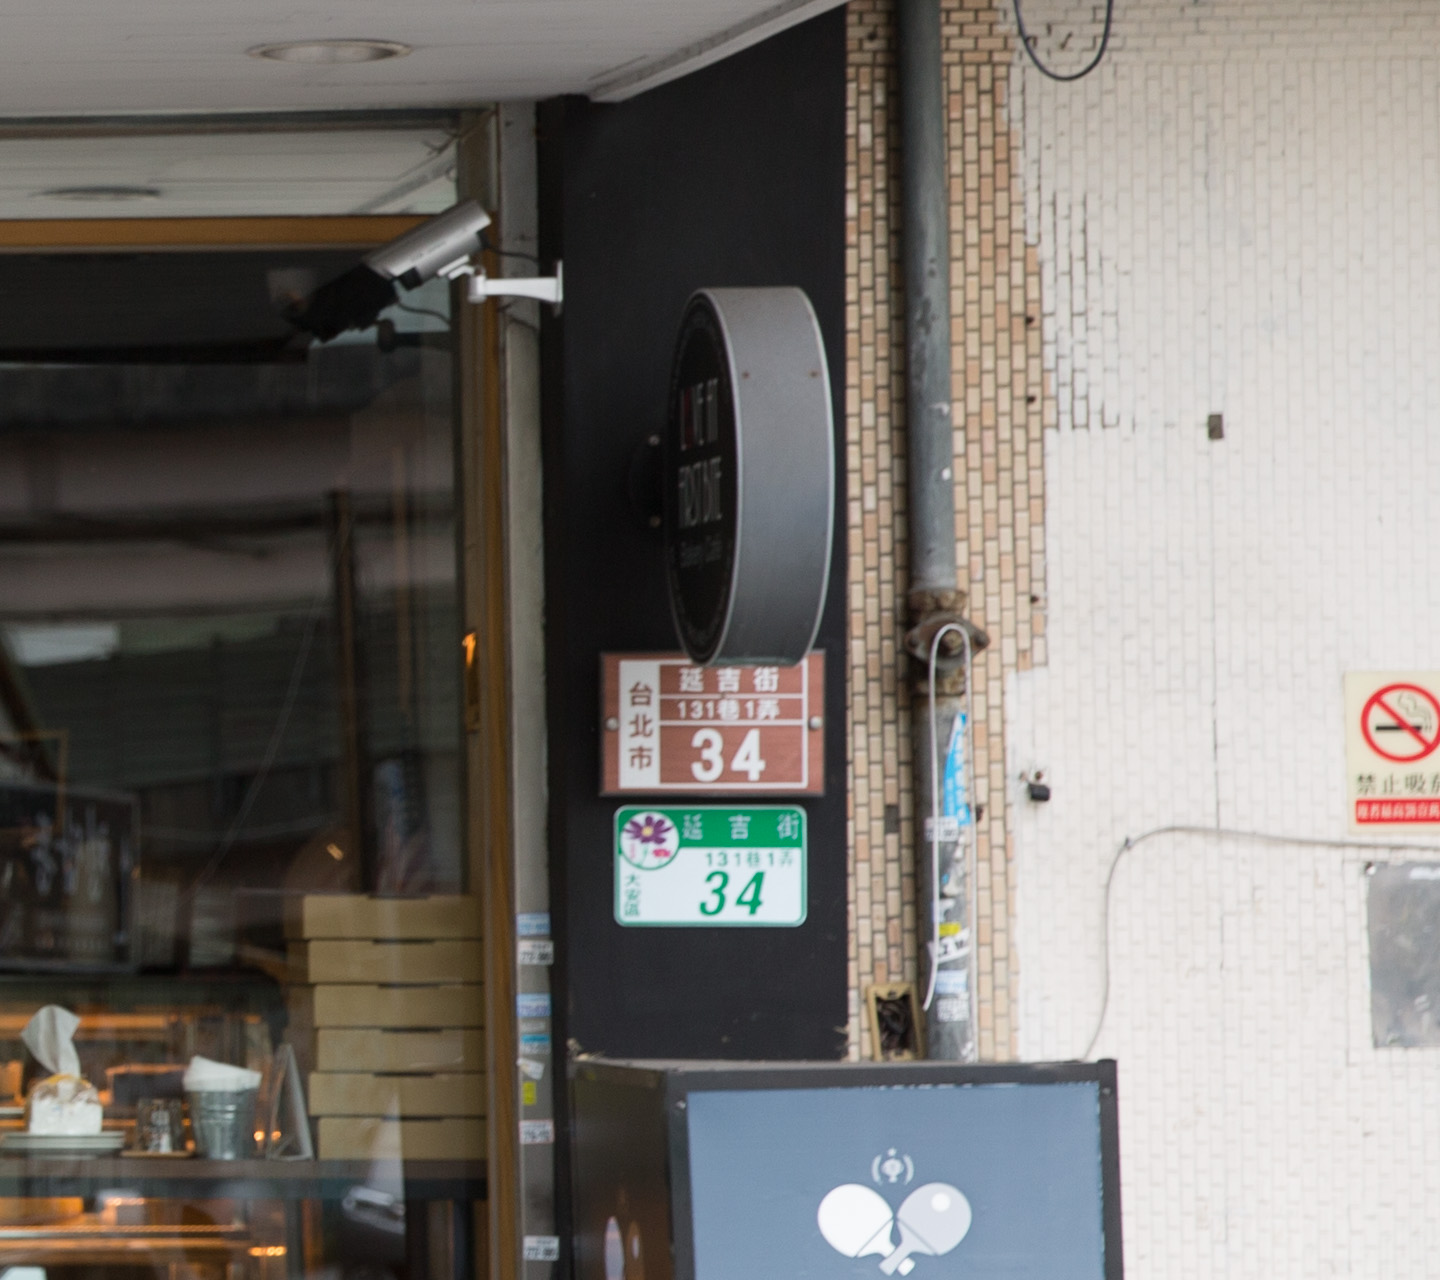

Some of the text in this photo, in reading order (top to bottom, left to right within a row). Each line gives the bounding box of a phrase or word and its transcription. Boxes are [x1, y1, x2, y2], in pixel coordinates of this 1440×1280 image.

[679, 666, 779, 693] 延吉街
[628, 681, 654, 770] 台北市
[677, 699, 780, 720] 131巷1弄
[690, 727, 766, 783] 34
[681, 813, 800, 841] 延吉街
[706, 851, 794, 868] 131巷1弄
[624, 873, 641, 918] 大安區
[699, 870, 766, 917] 34
